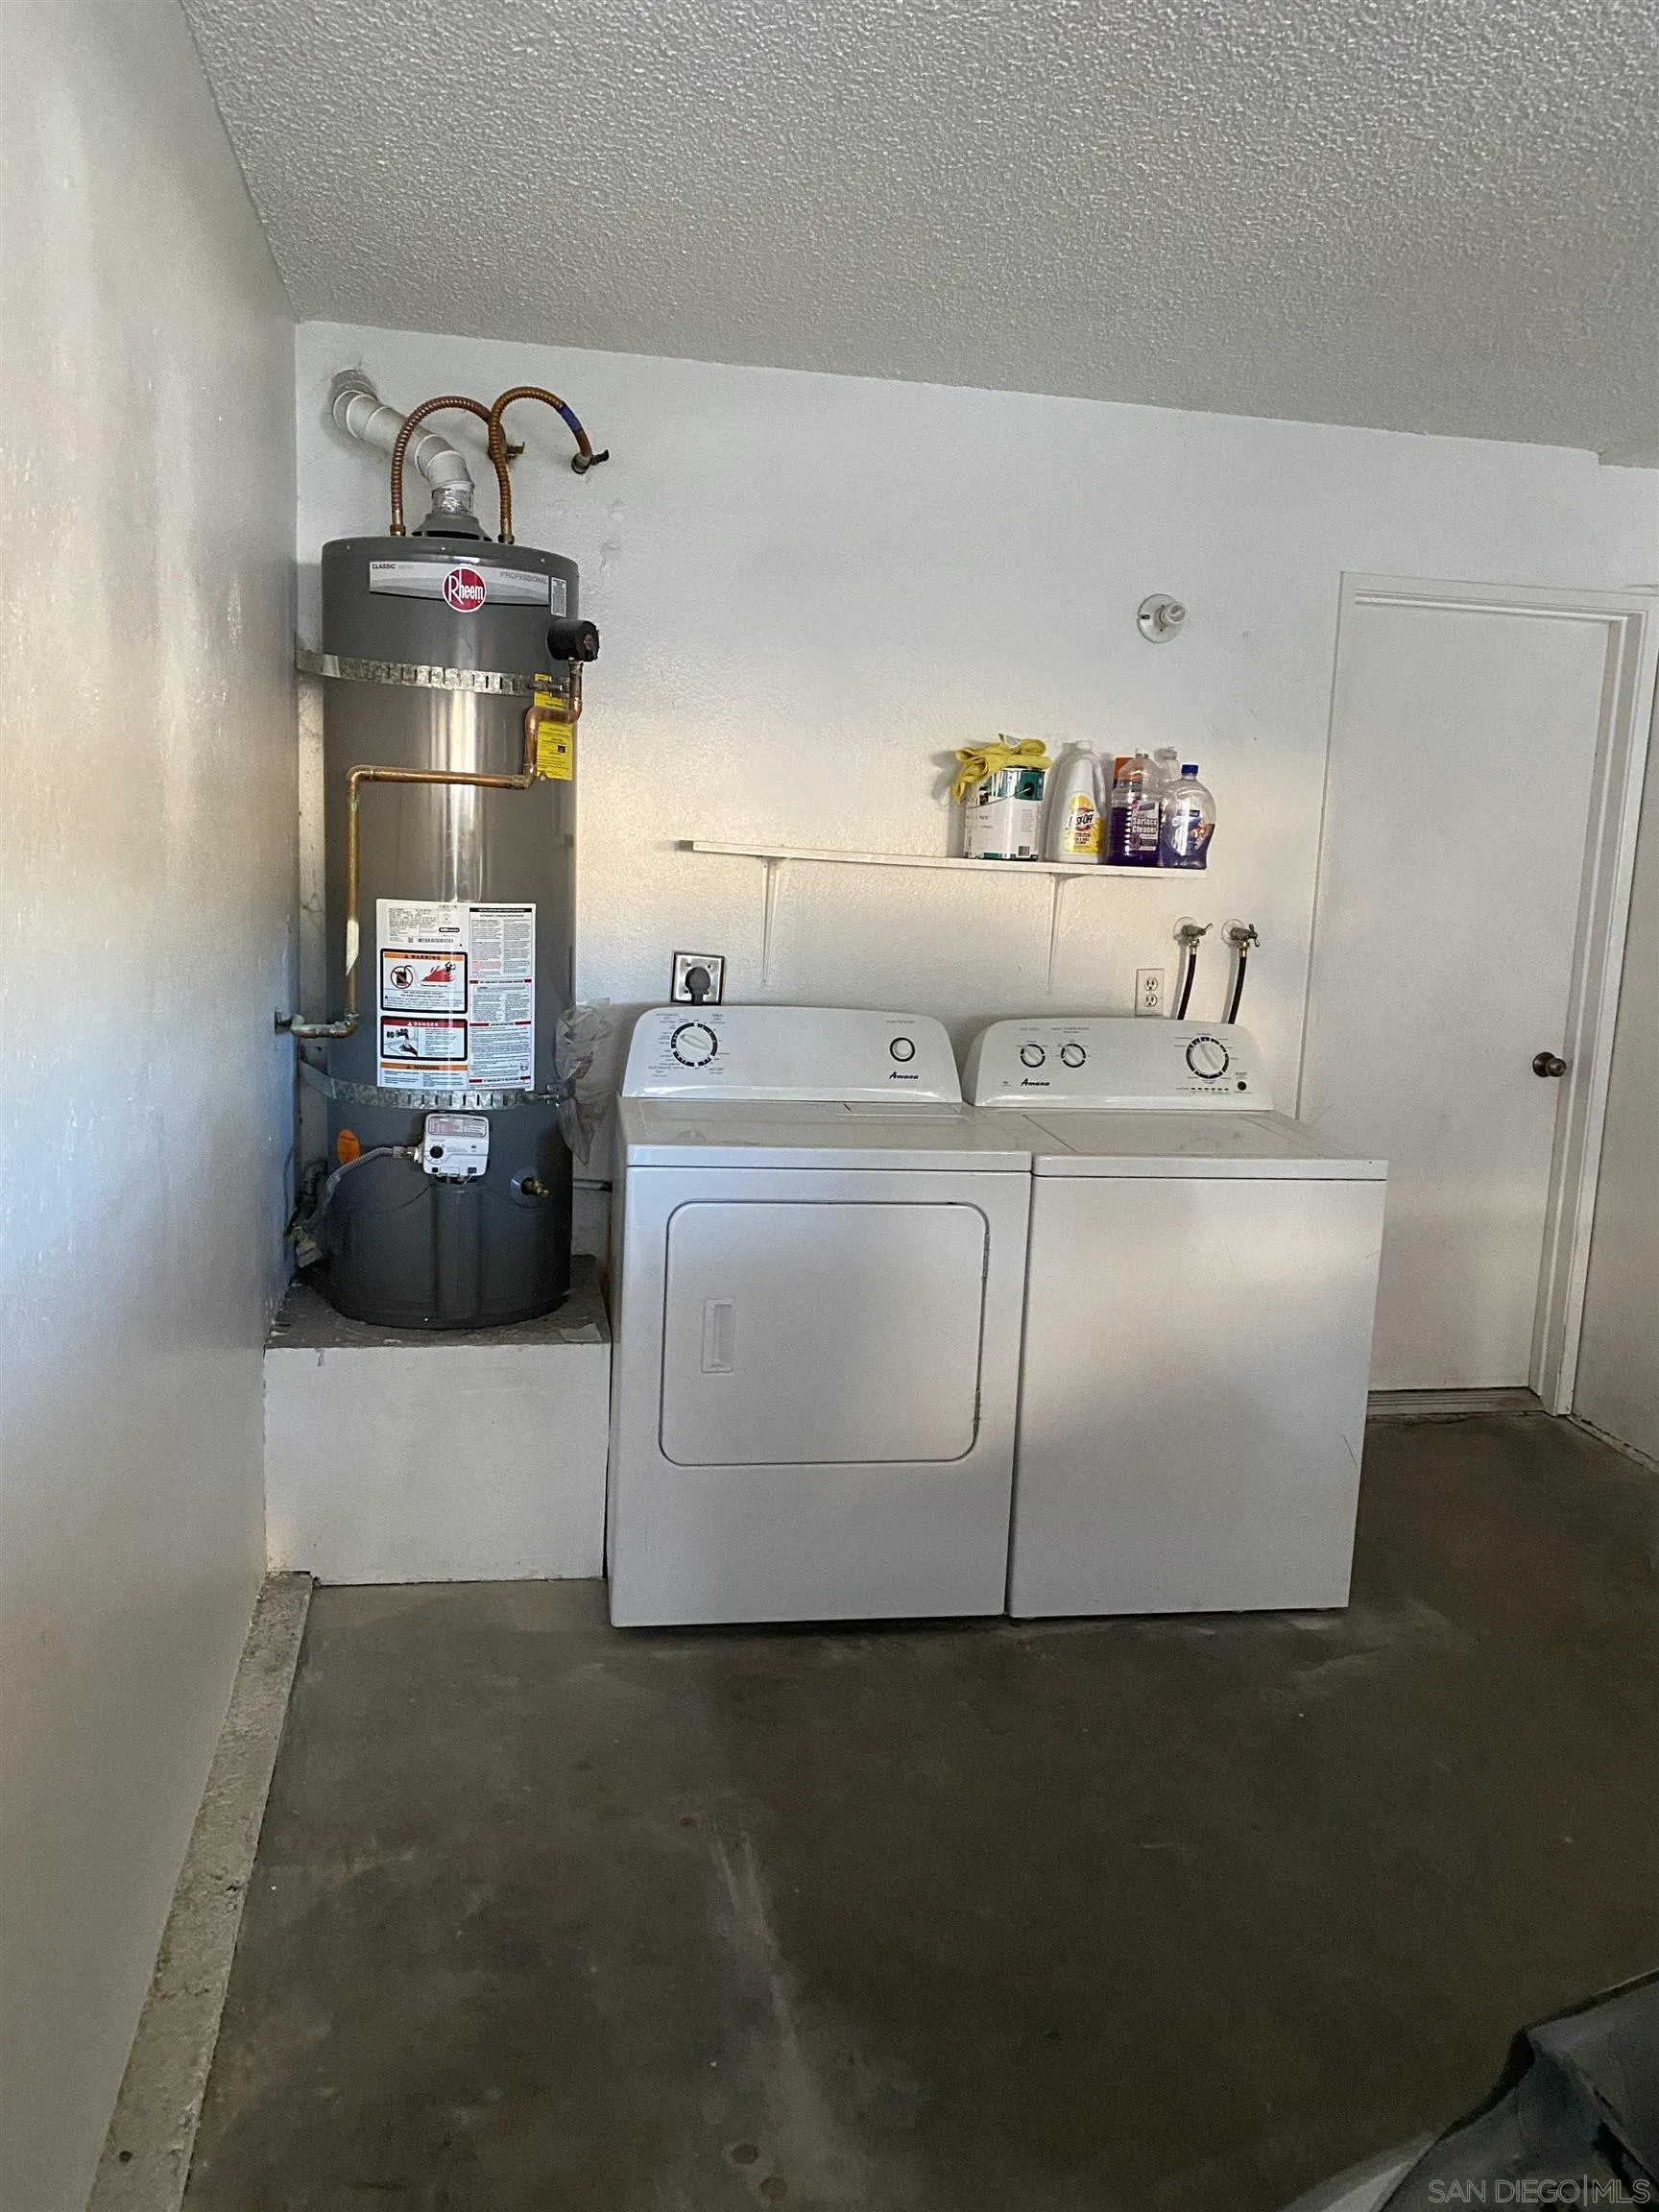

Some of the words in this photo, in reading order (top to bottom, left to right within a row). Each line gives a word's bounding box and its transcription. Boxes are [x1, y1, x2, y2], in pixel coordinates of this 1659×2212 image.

[499, 570, 548, 585] PROFESSIONAL
[447, 568, 484, 605] Rheem
[1132, 817, 1158, 826] Surface
[1132, 826, 1158, 834] Cleaner
[1021, 1078, 1050, 1087] Amana
